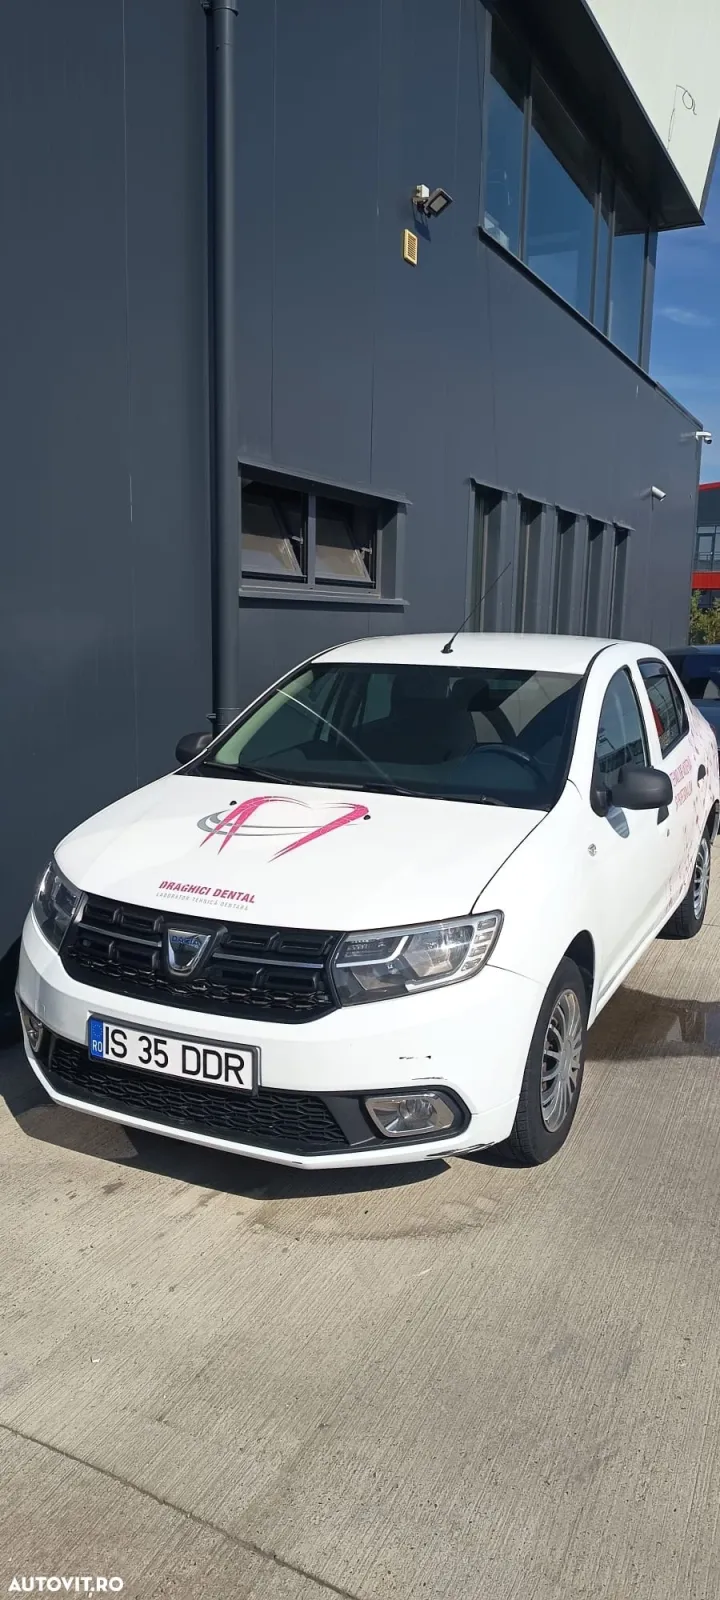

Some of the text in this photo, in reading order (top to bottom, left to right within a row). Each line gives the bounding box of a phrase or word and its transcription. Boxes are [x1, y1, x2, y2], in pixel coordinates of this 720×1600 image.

[156, 892, 190, 902] LABORATOR
[158, 880, 256, 904] DRAGHICI DENTAL
[92, 1039, 103, 1053] RO
[104, 1026, 245, 1085] IS 35 DDR
